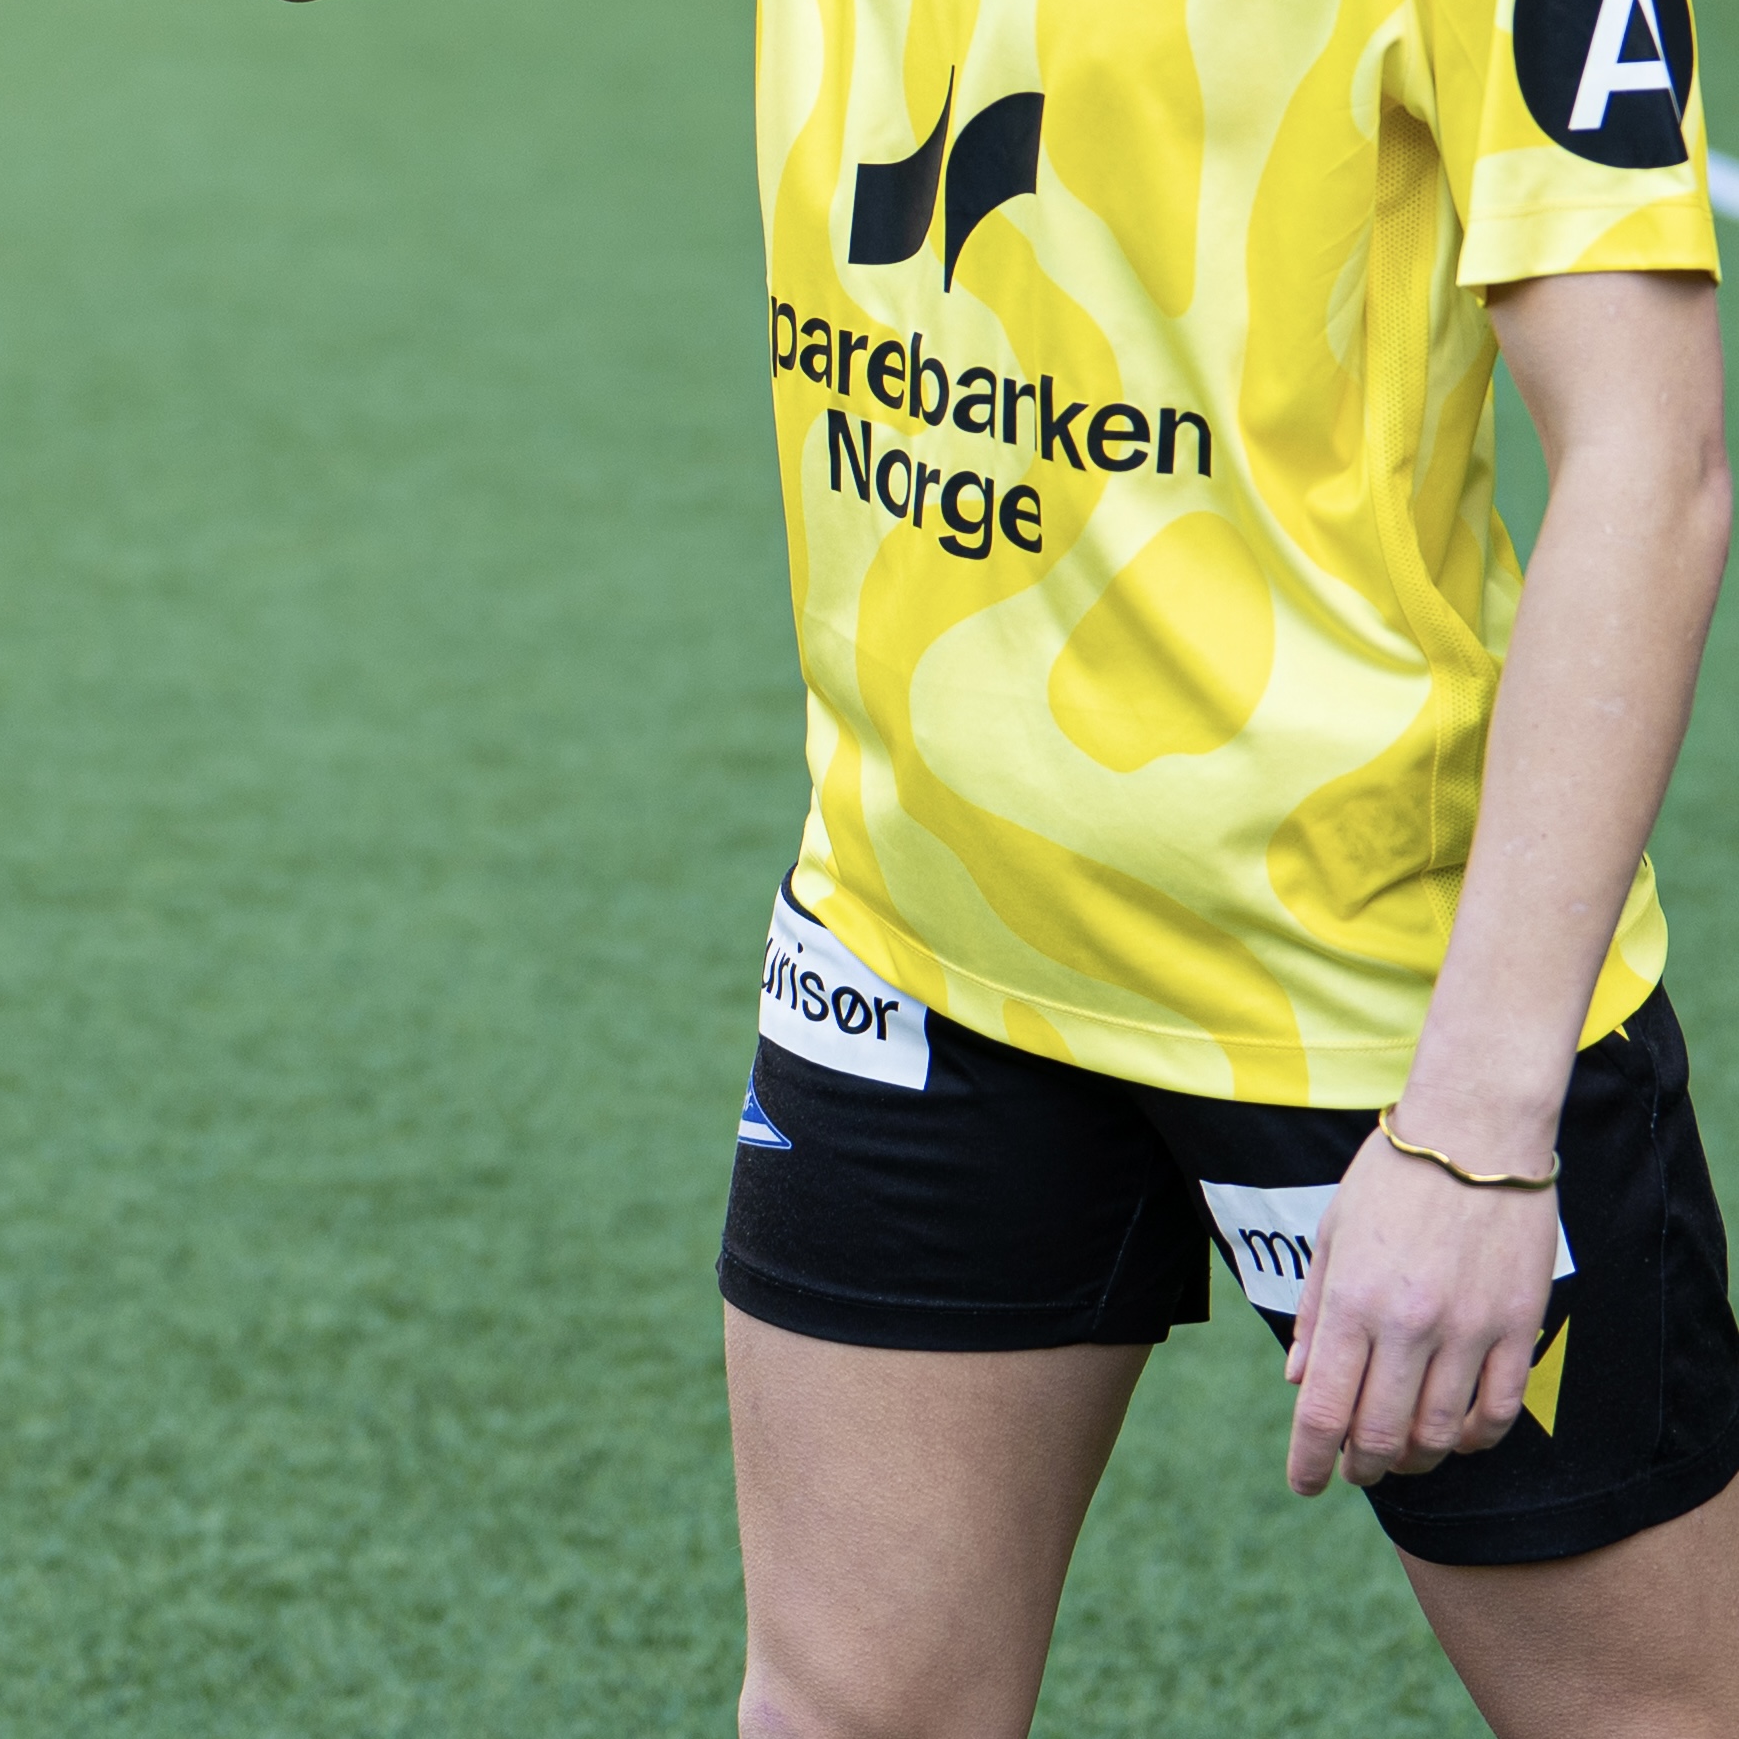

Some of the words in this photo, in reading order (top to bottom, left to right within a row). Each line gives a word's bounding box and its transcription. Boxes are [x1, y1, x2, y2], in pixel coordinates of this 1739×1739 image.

[771, 294, 1212, 478] parebanken
[827, 408, 1043, 561] Norge
[761, 937, 899, 1041] urisør
